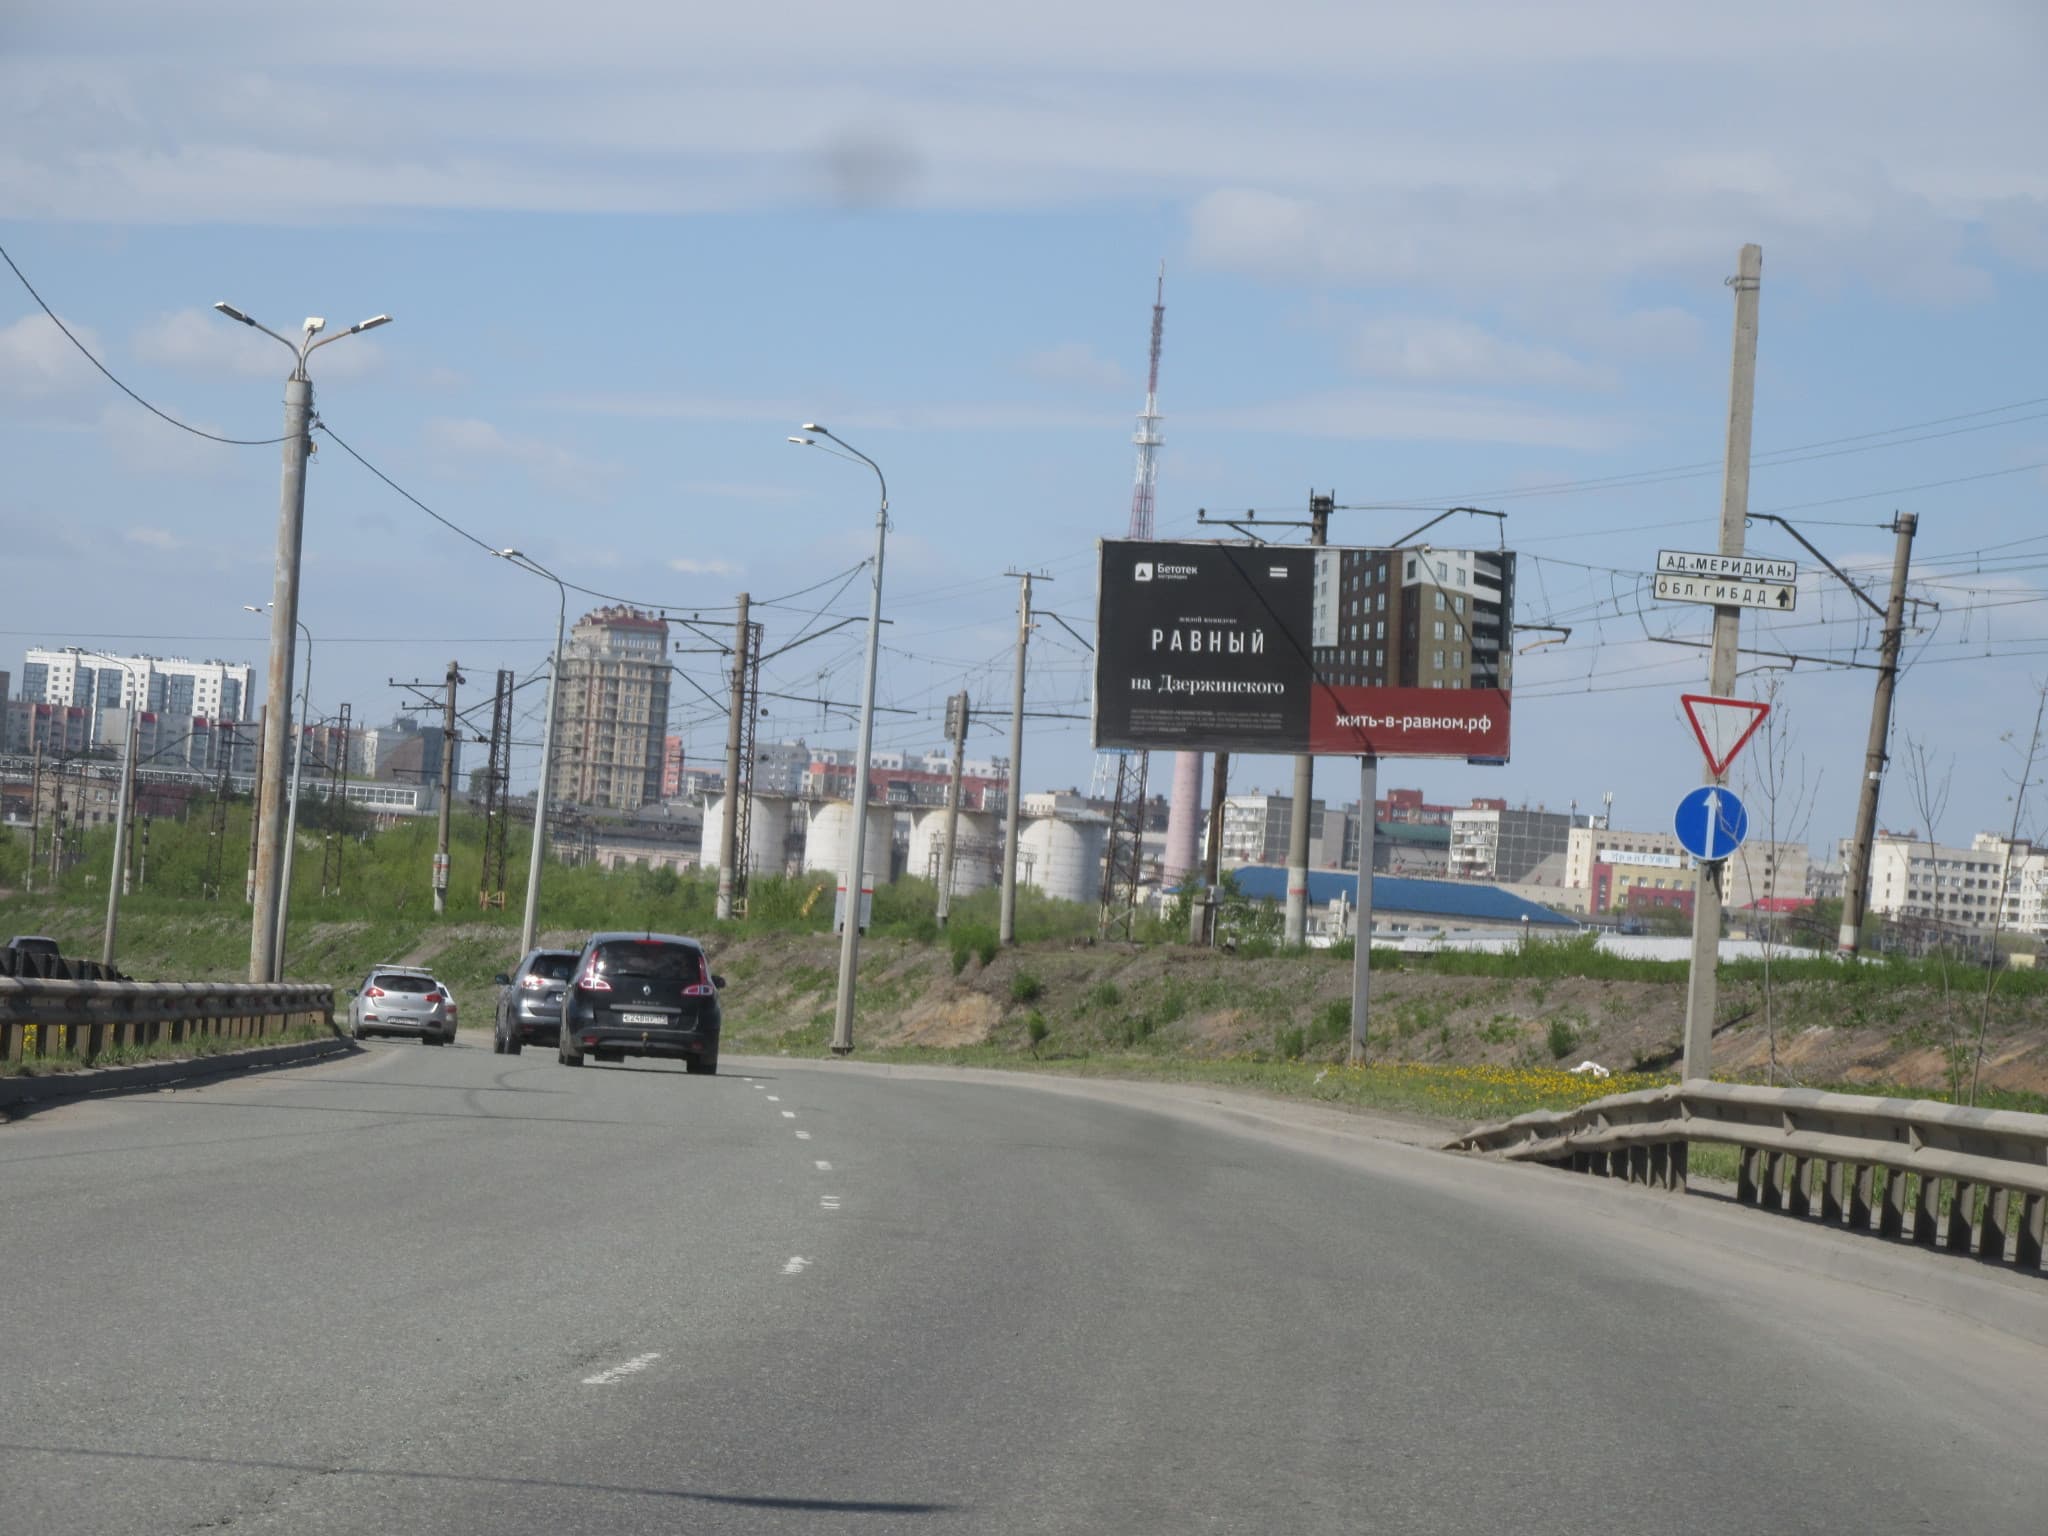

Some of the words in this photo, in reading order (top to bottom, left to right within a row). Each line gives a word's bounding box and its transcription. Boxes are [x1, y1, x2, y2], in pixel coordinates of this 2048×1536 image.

[1157, 563, 1198, 575] Бетотек
[1703, 585, 1766, 604] ГИБДД
[1151, 628, 1264, 654] РАВНЫЙ
[1130, 677, 1152, 690] на
[1158, 674, 1285, 695] Дзержинского
[1336, 714, 1492, 734] жить-в-равном.рф
